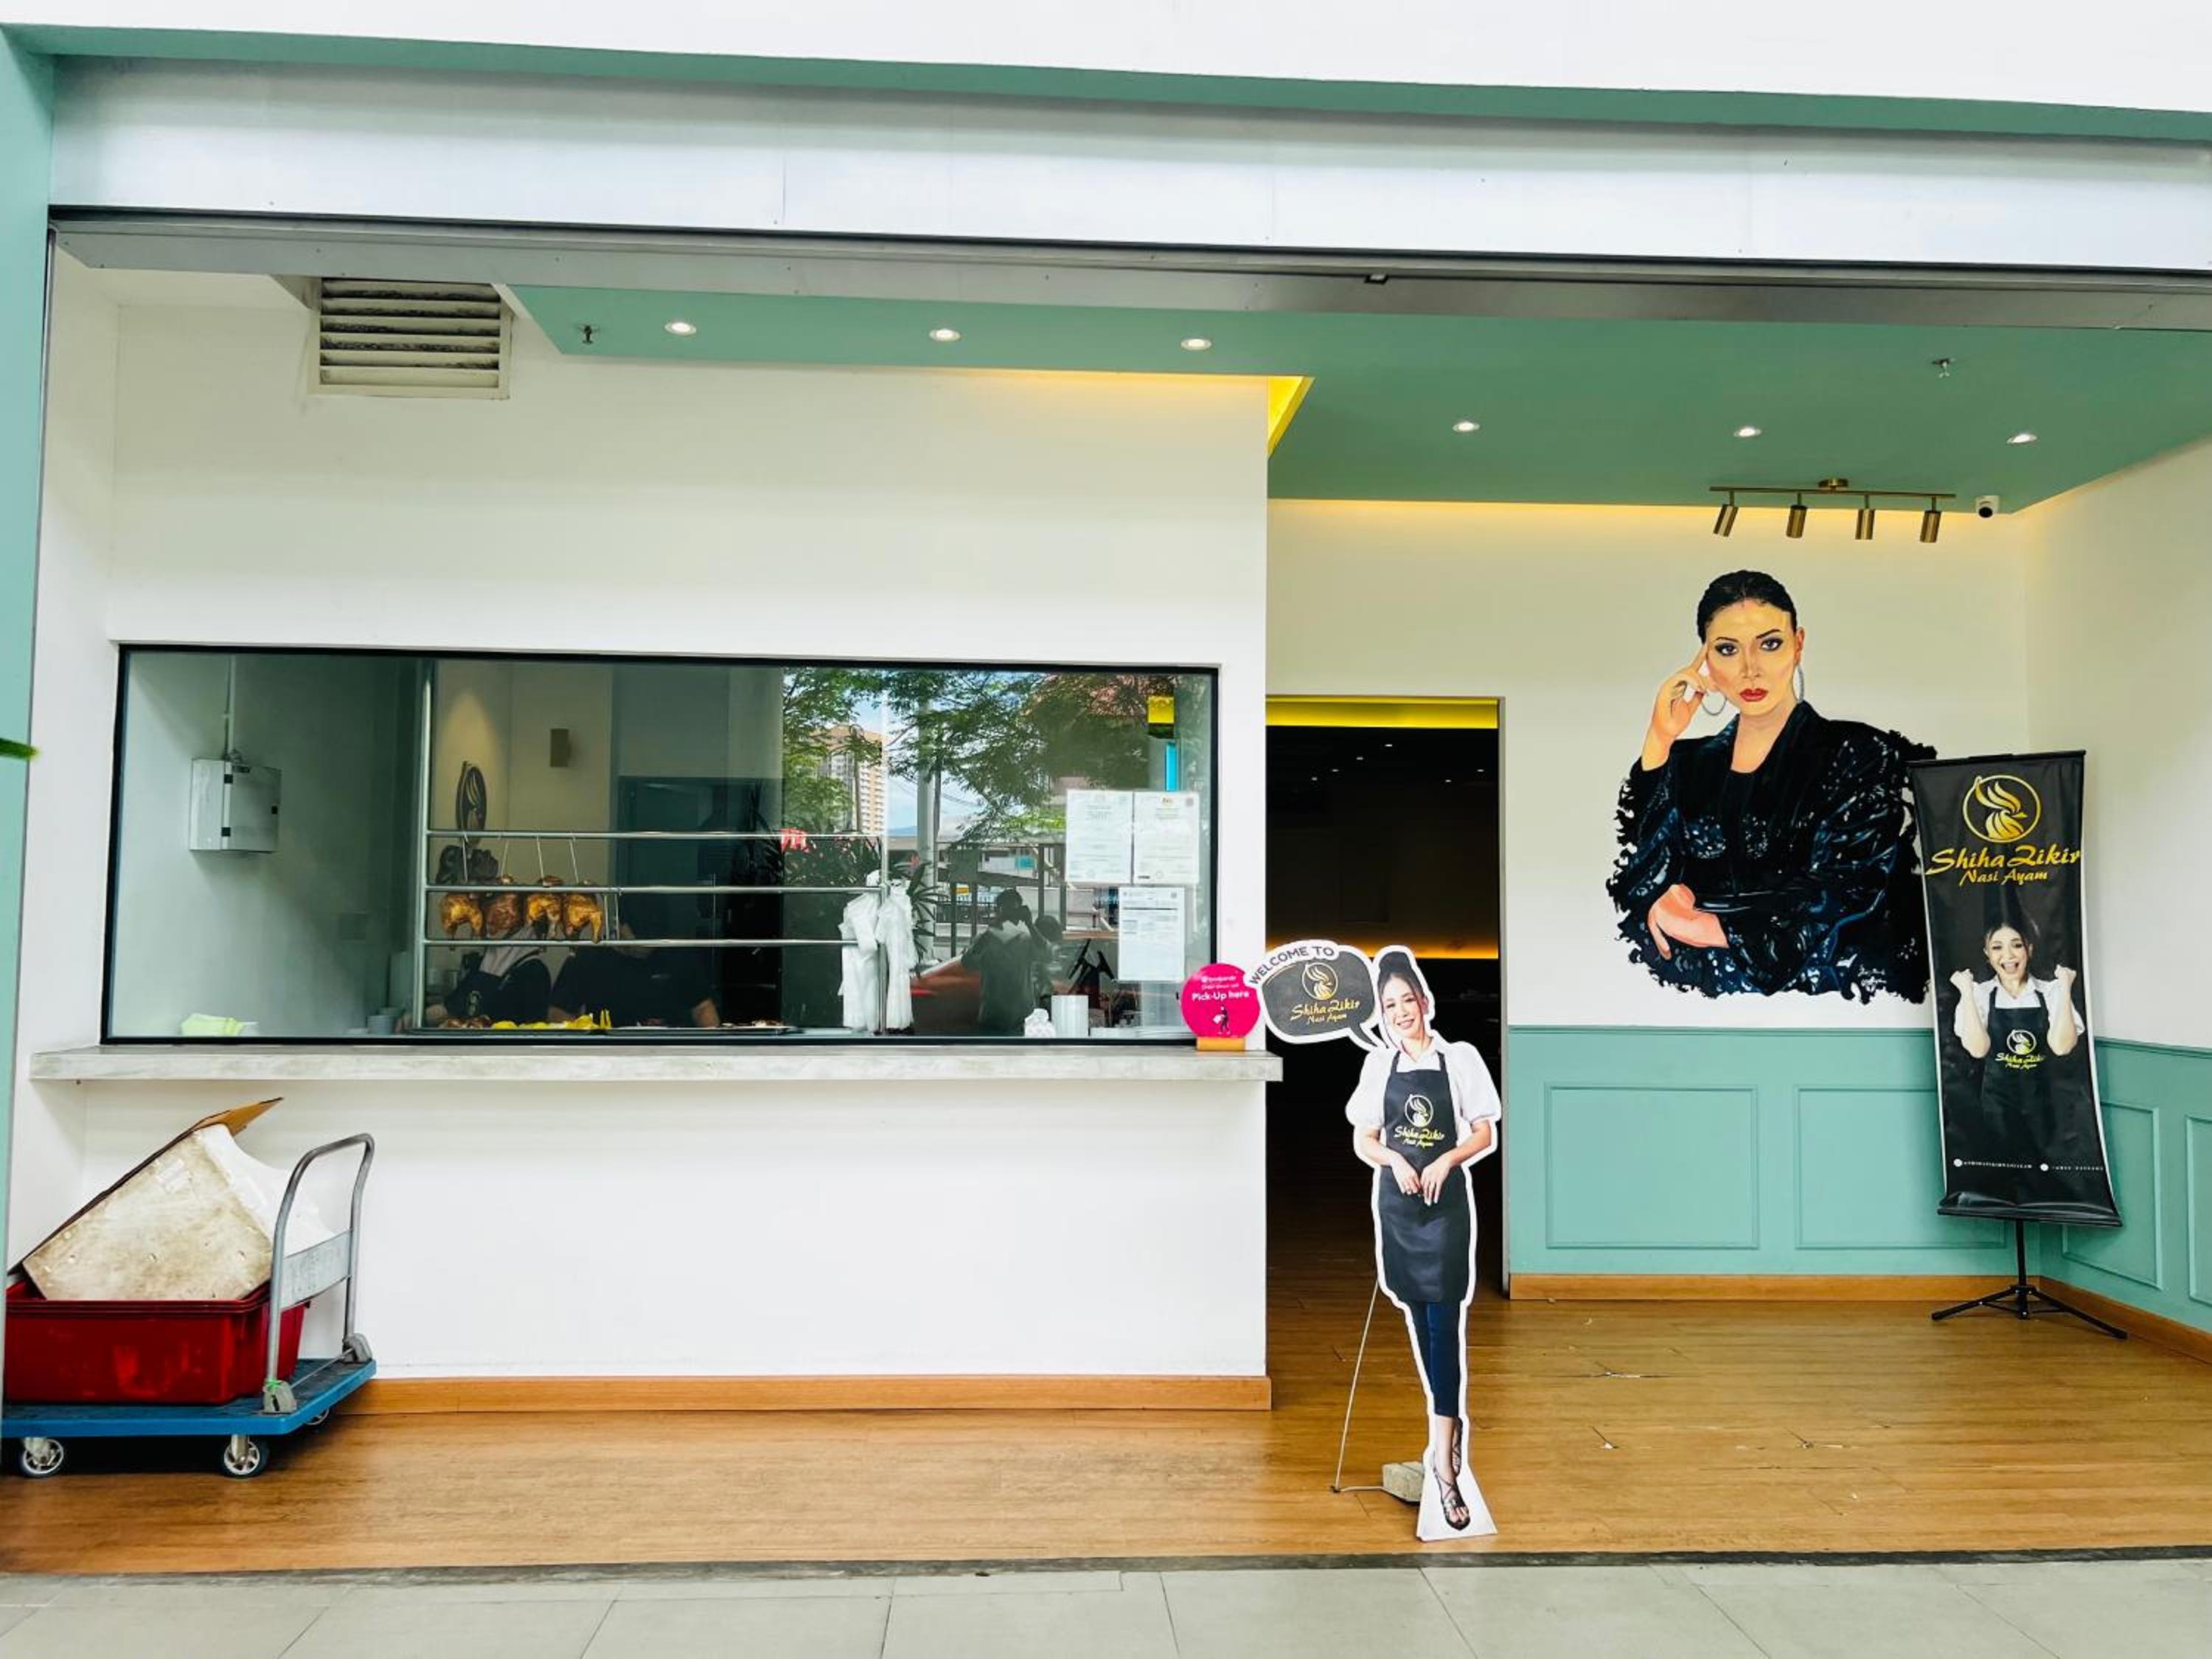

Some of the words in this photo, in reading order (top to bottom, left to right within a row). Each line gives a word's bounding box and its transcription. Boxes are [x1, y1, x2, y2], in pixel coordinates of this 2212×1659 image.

[1925, 847, 2005, 875] Shiha
[2006, 844, 2081, 866] Zikir
[1958, 869, 1999, 886] Nasi
[2000, 868, 2048, 886] Ayam
[1249, 946, 1310, 984] WELCOME
[1312, 946, 1334, 956] TO
[1192, 991, 1227, 1001] Pick-Up
[1228, 990, 1250, 998] here
[1290, 1001, 1326, 1021] Shiha
